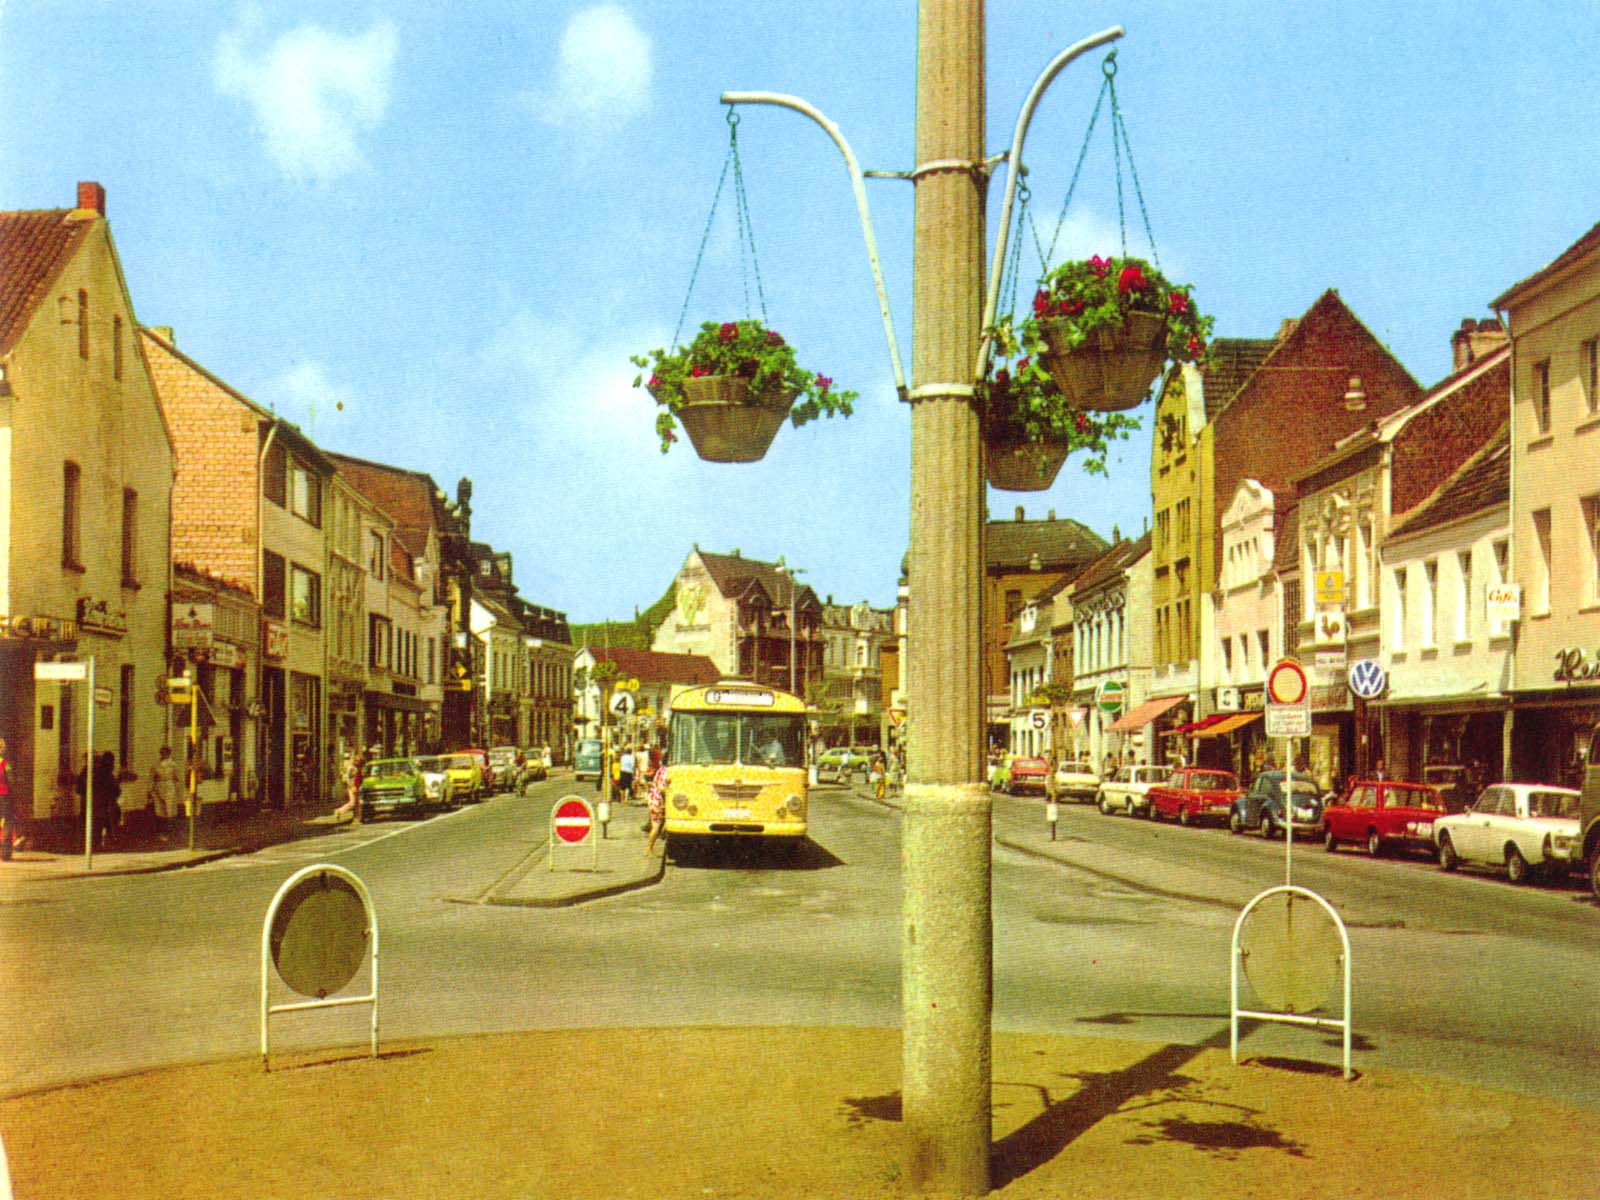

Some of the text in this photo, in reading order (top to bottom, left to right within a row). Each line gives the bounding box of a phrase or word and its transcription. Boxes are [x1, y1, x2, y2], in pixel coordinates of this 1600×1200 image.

[1352, 662, 1384, 697] VW
[614, 696, 628, 714] 4
[1033, 712, 1046, 729] 5
